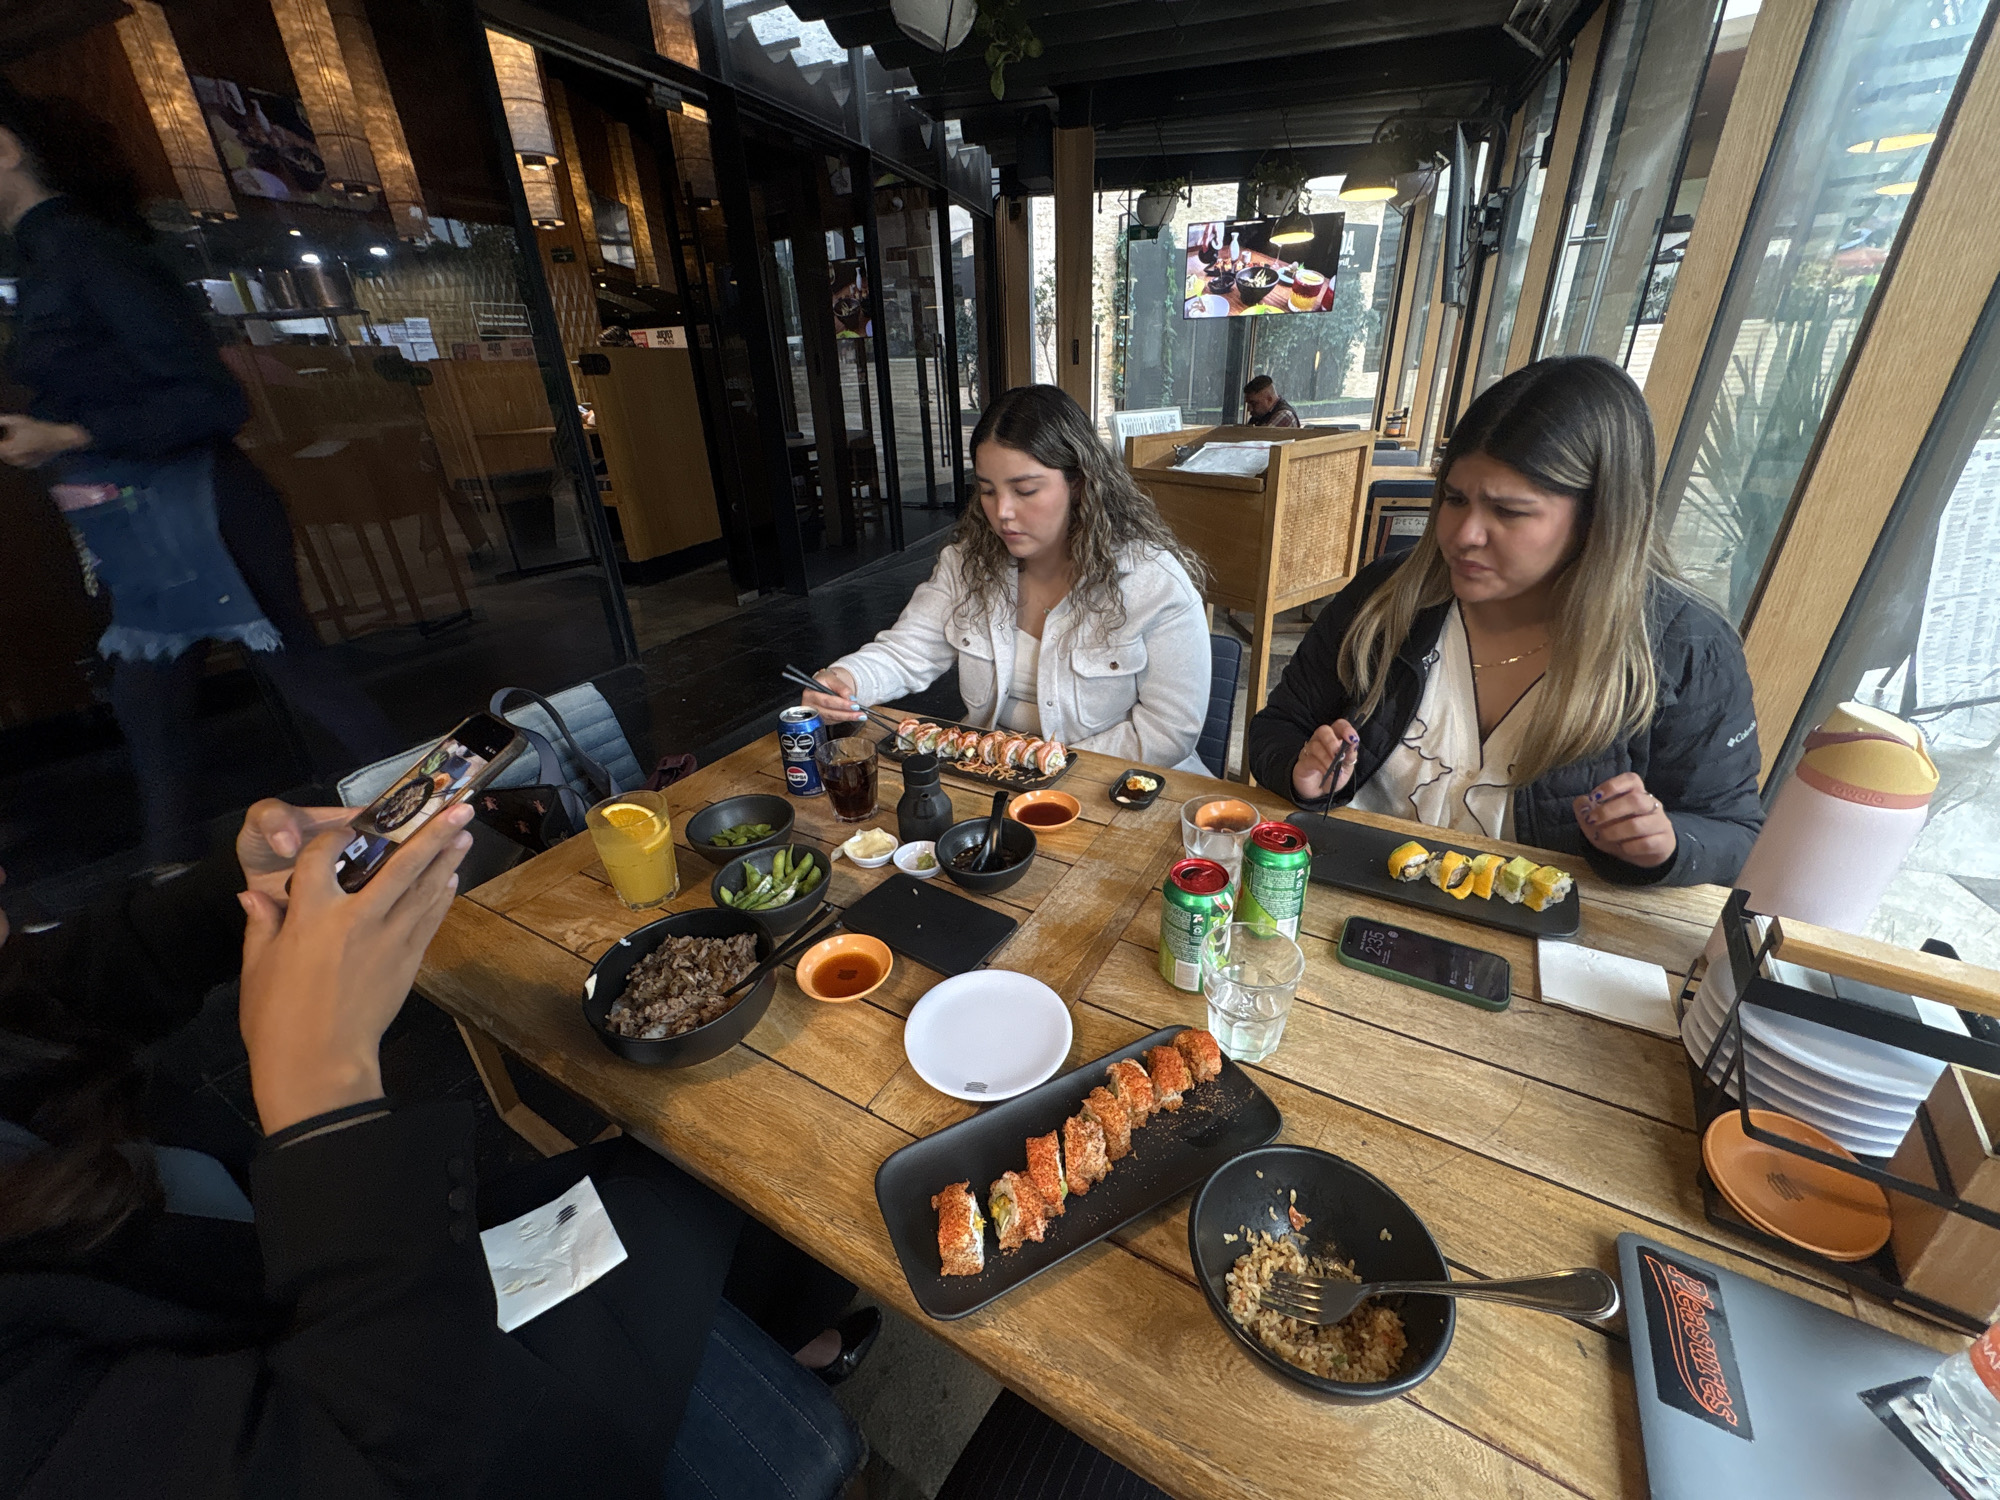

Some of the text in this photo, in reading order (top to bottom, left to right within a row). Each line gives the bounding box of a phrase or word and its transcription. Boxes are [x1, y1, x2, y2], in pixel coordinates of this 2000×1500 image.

[788, 773, 807, 781] PEPSI
[1364, 930, 1386, 957] 2:35
[1666, 1263, 1739, 1428] Pleasures
